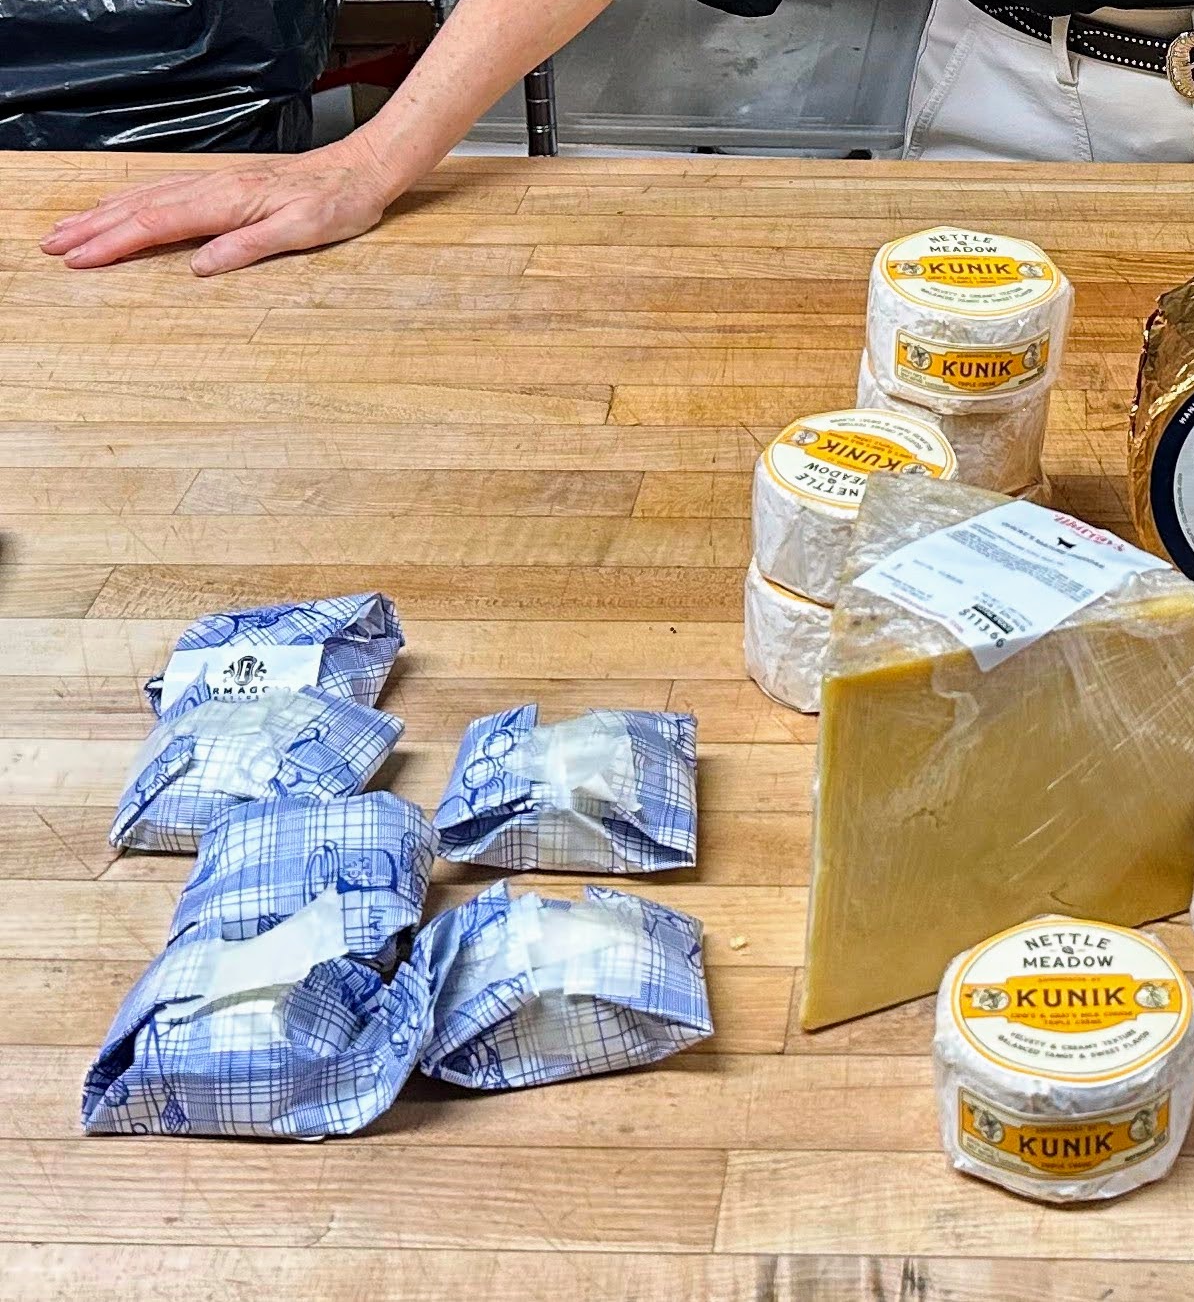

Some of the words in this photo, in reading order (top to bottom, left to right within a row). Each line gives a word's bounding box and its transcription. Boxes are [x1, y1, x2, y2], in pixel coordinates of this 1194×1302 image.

[928, 233, 995, 244] NETTLE
[929, 262, 1013, 275] KUNIK
[941, 359, 1014, 379] KUNIK
[817, 438, 902, 472] KUNIK
[794, 472, 860, 498] NETTLE
[1023, 932, 1112, 951] NETTLE
[1022, 955, 1114, 969] MEADOW
[1016, 986, 1126, 1008] KUNIK
[1018, 1130, 1115, 1159] KUNIK
